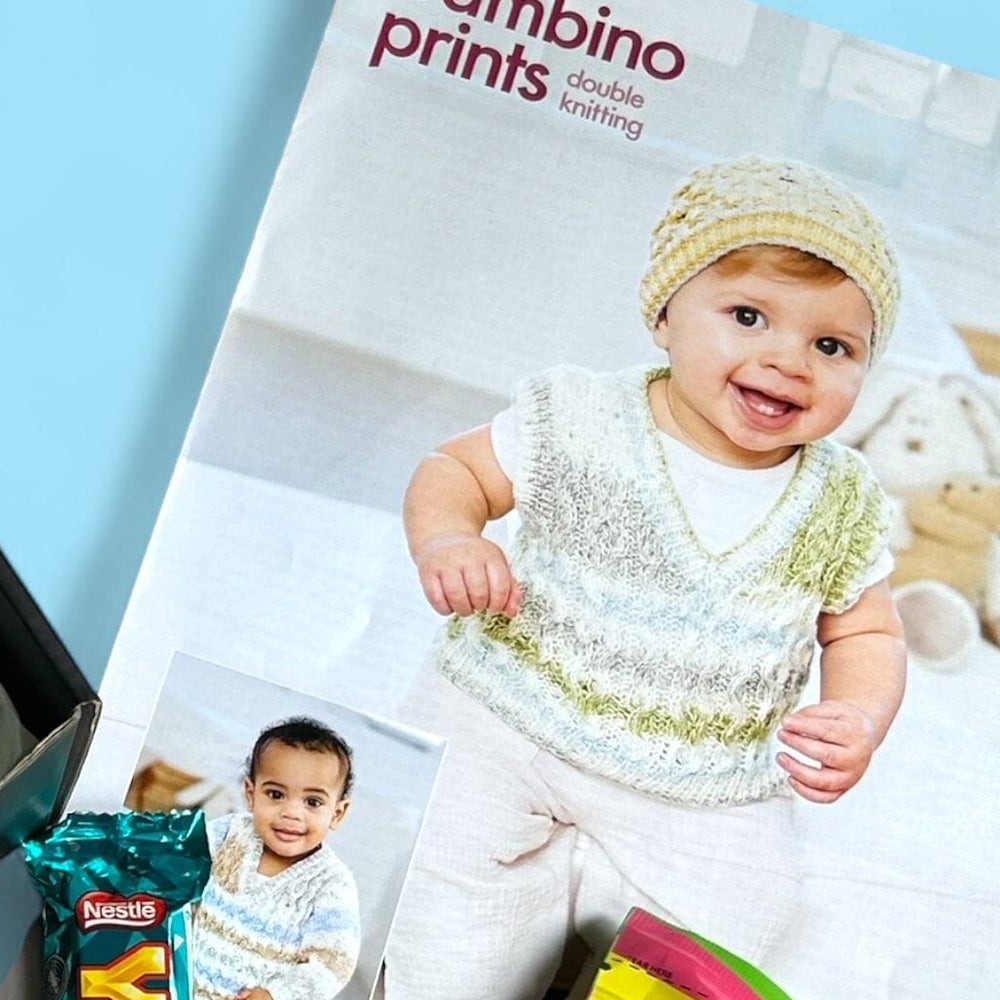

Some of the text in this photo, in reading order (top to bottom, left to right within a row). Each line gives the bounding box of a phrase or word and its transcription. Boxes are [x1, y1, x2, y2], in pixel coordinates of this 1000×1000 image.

[368, 12, 550, 102] prints
[443, 0, 685, 81] mbino
[558, 92, 644, 141] knitting
[566, 70, 645, 109] double
